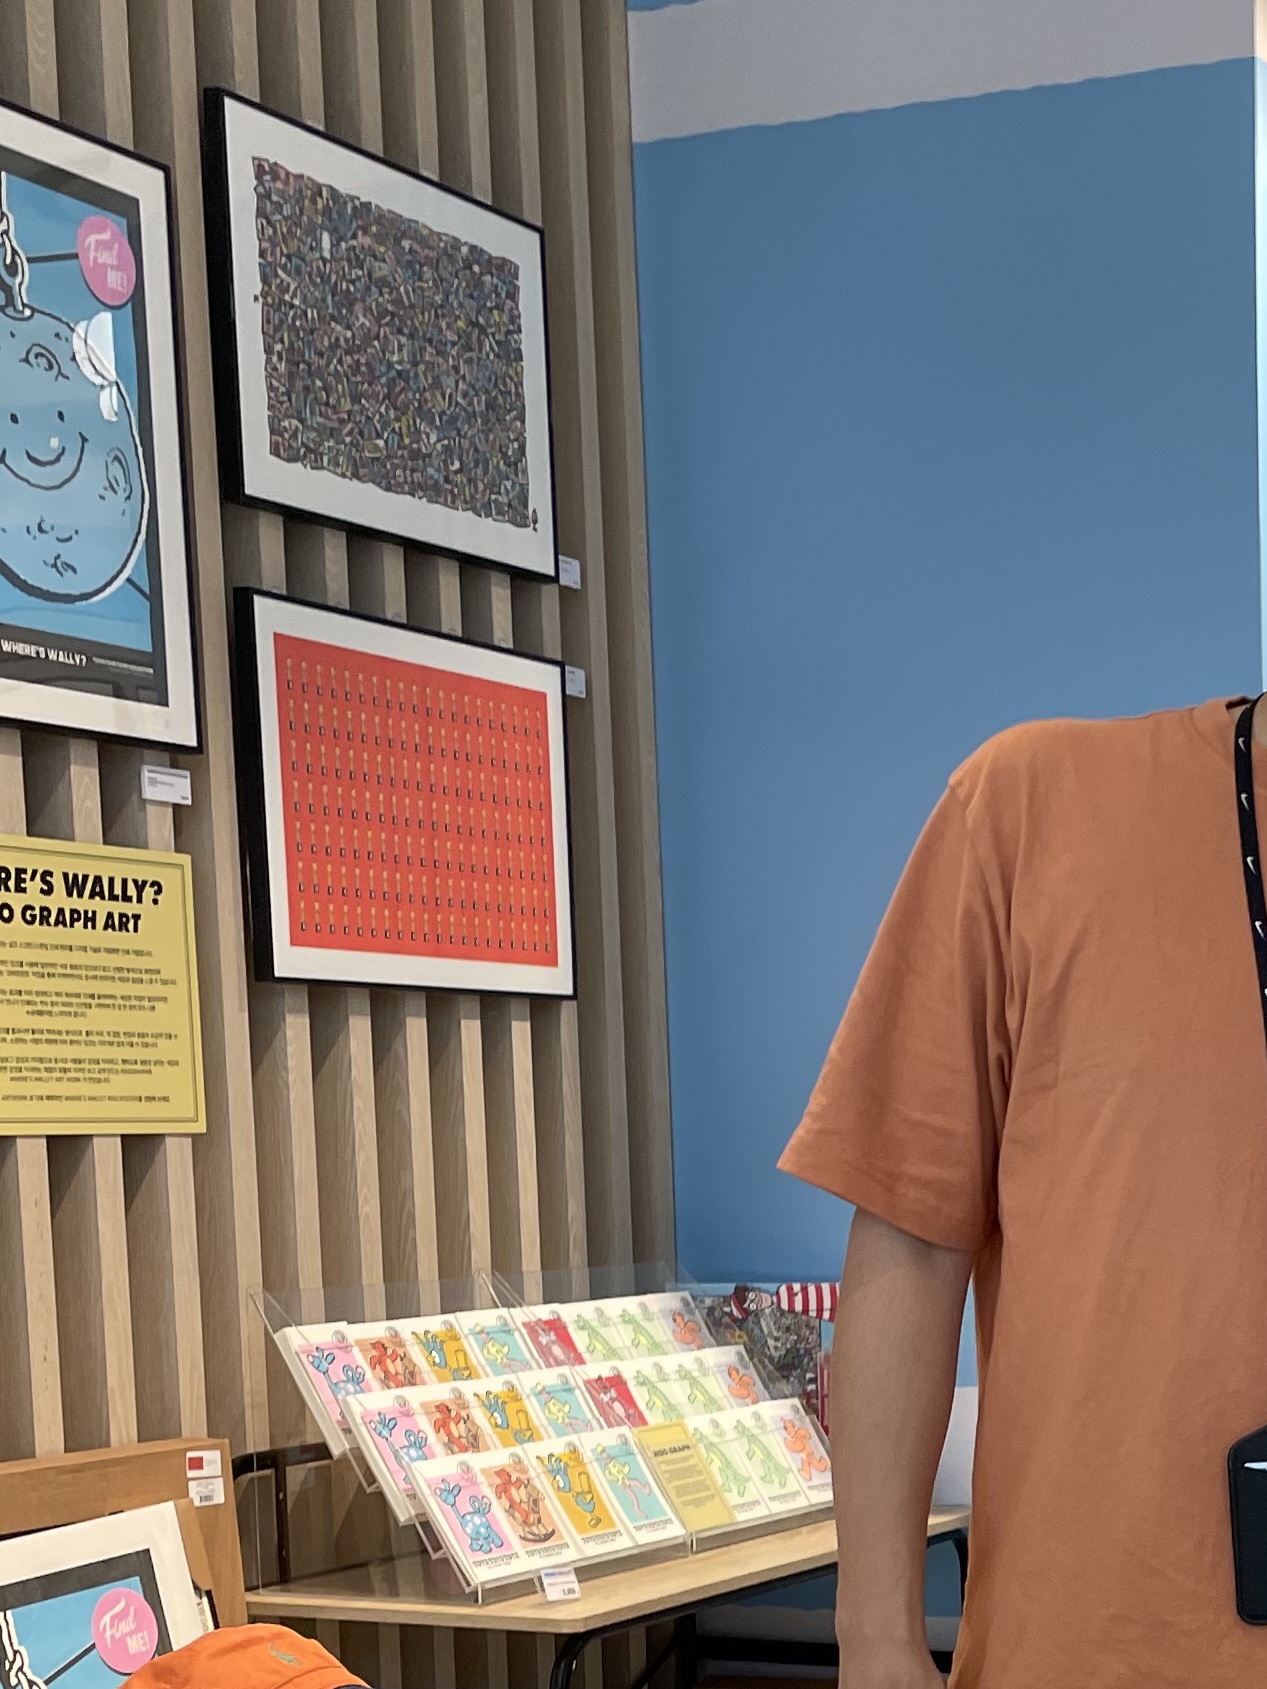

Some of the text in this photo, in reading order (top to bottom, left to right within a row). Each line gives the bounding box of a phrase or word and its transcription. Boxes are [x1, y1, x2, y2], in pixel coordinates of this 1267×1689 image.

[47, 648, 87, 667] WALLY?
[62, 871, 163, 906] WALLY?
[21, 904, 97, 930] GRAPH
[102, 911, 142, 934] ART
[99, 1596, 137, 1650] Find
[126, 1630, 151, 1655] ME!
